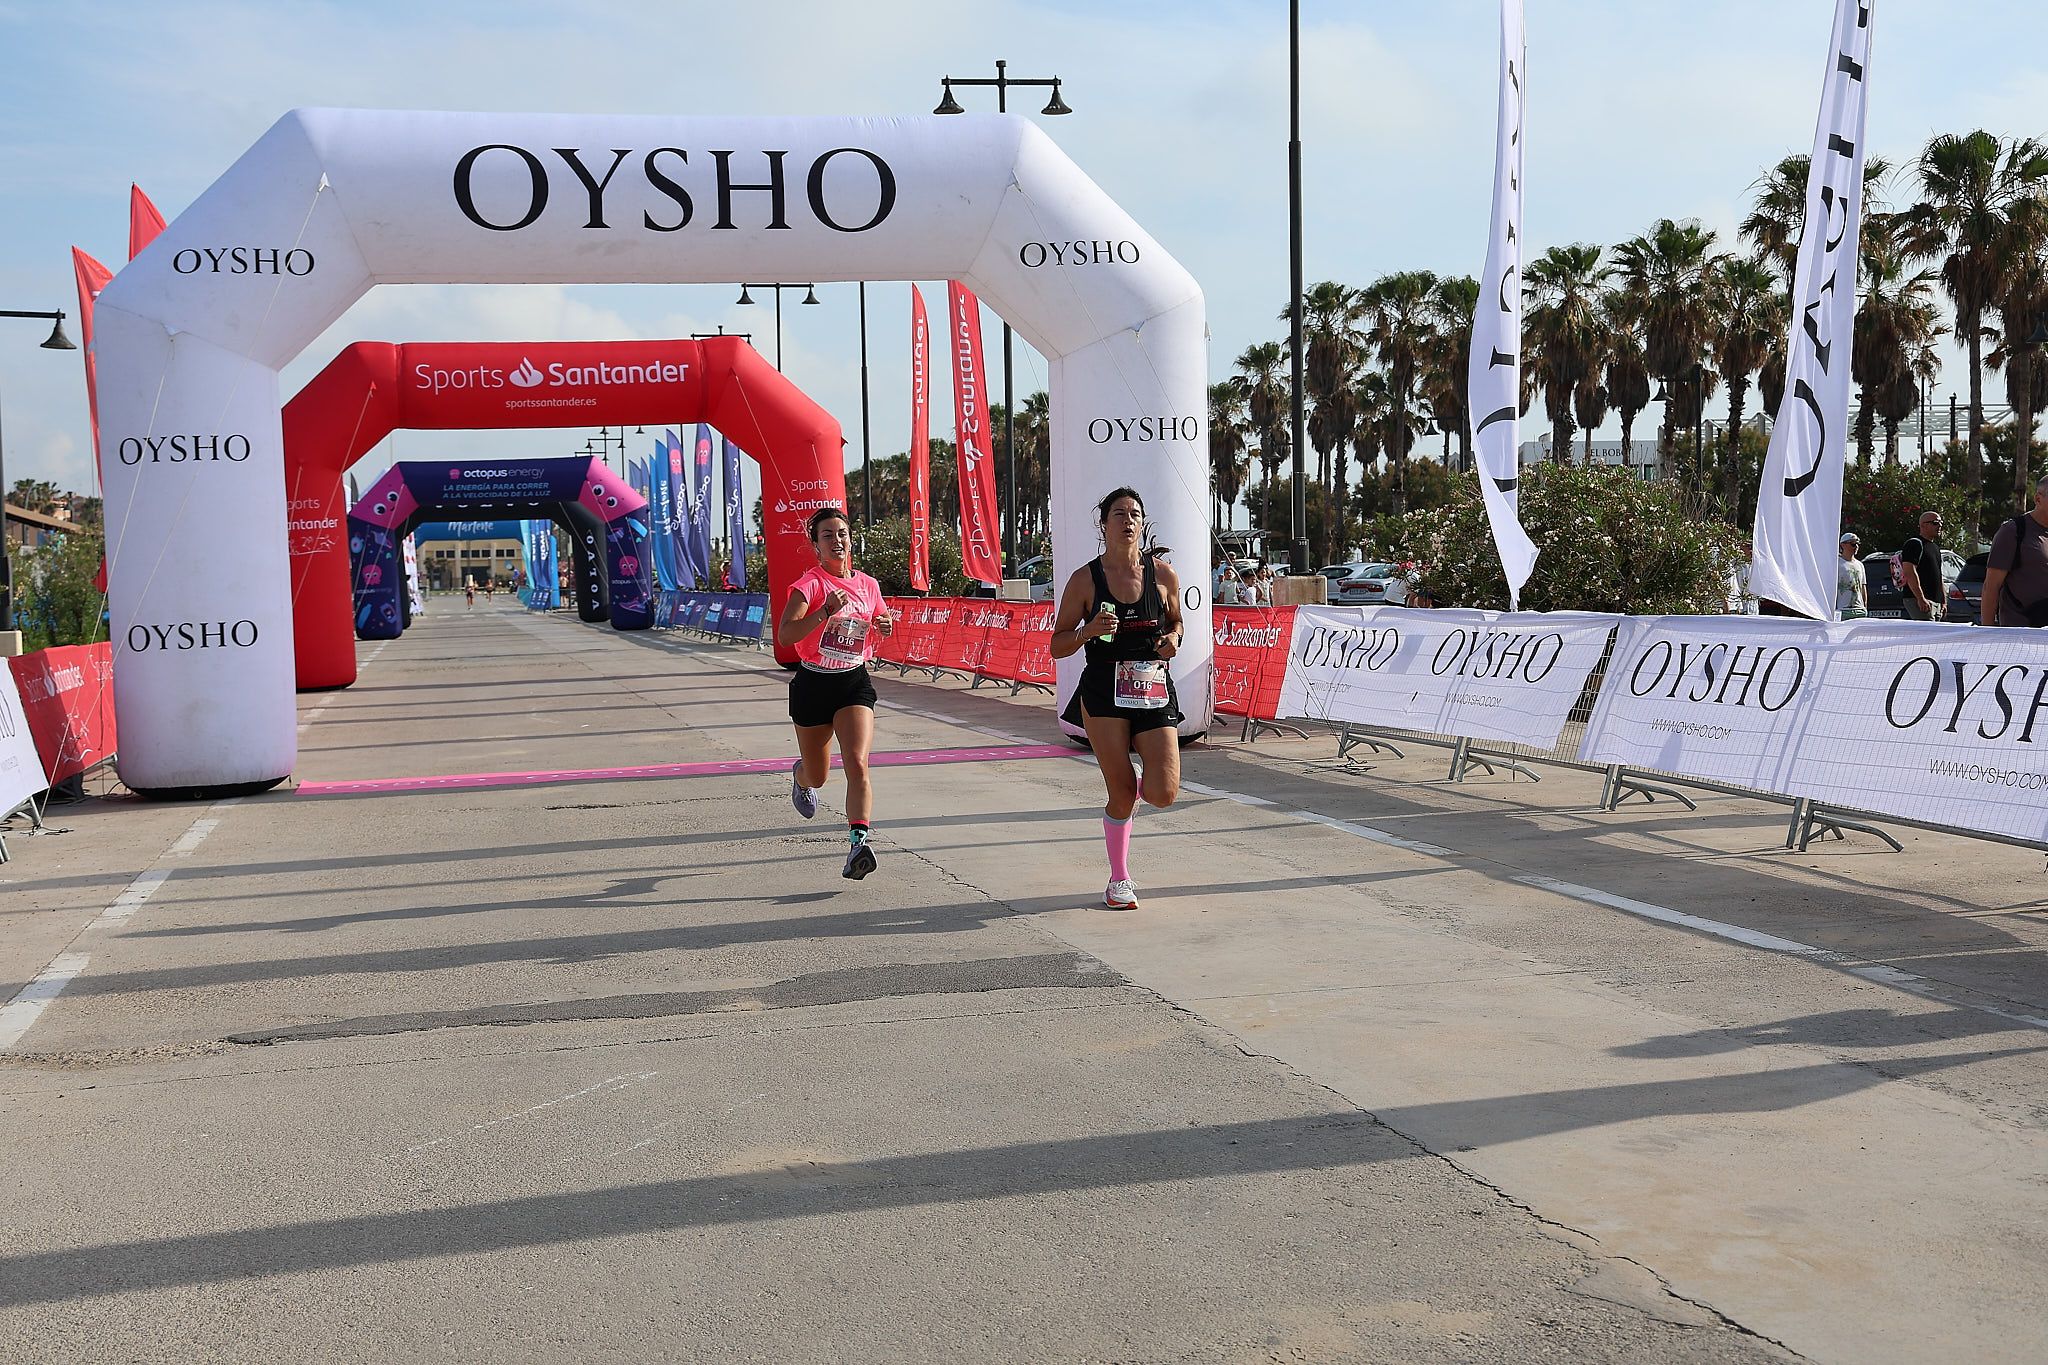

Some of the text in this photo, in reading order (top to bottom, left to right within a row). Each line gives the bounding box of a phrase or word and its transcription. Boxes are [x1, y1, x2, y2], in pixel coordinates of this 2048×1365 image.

[453, 143, 897, 232] OYSHO
[173, 247, 315, 276] OYSHO
[1019, 240, 1140, 268] OYSHO
[415, 360, 689, 395] Sports Santander
[505, 396, 597, 410] sportssantander.es
[1088, 416, 1199, 444] OYSHO
[119, 433, 251, 466] OYSHO
[455, 482, 492, 491] ENERGÍA
[492, 483, 516, 491] PARA
[516, 482, 549, 490] CORRER
[463, 468, 545, 480] octopus energy
[790, 480, 829, 493] Sports
[789, 498, 843, 511] Santander
[586, 535, 600, 611] VOLVO
[128, 619, 259, 652] OYSHO
[837, 635, 855, 646] 016
[1226, 622, 1281, 648] Santander
[1303, 626, 1400, 671] OYSHO
[1431, 628, 1564, 684] OYSHO
[1133, 680, 1153, 690] 016
[1630, 640, 1805, 712] OYSHO
[1651, 718, 1732, 740] WWW.OYSHO.COM
